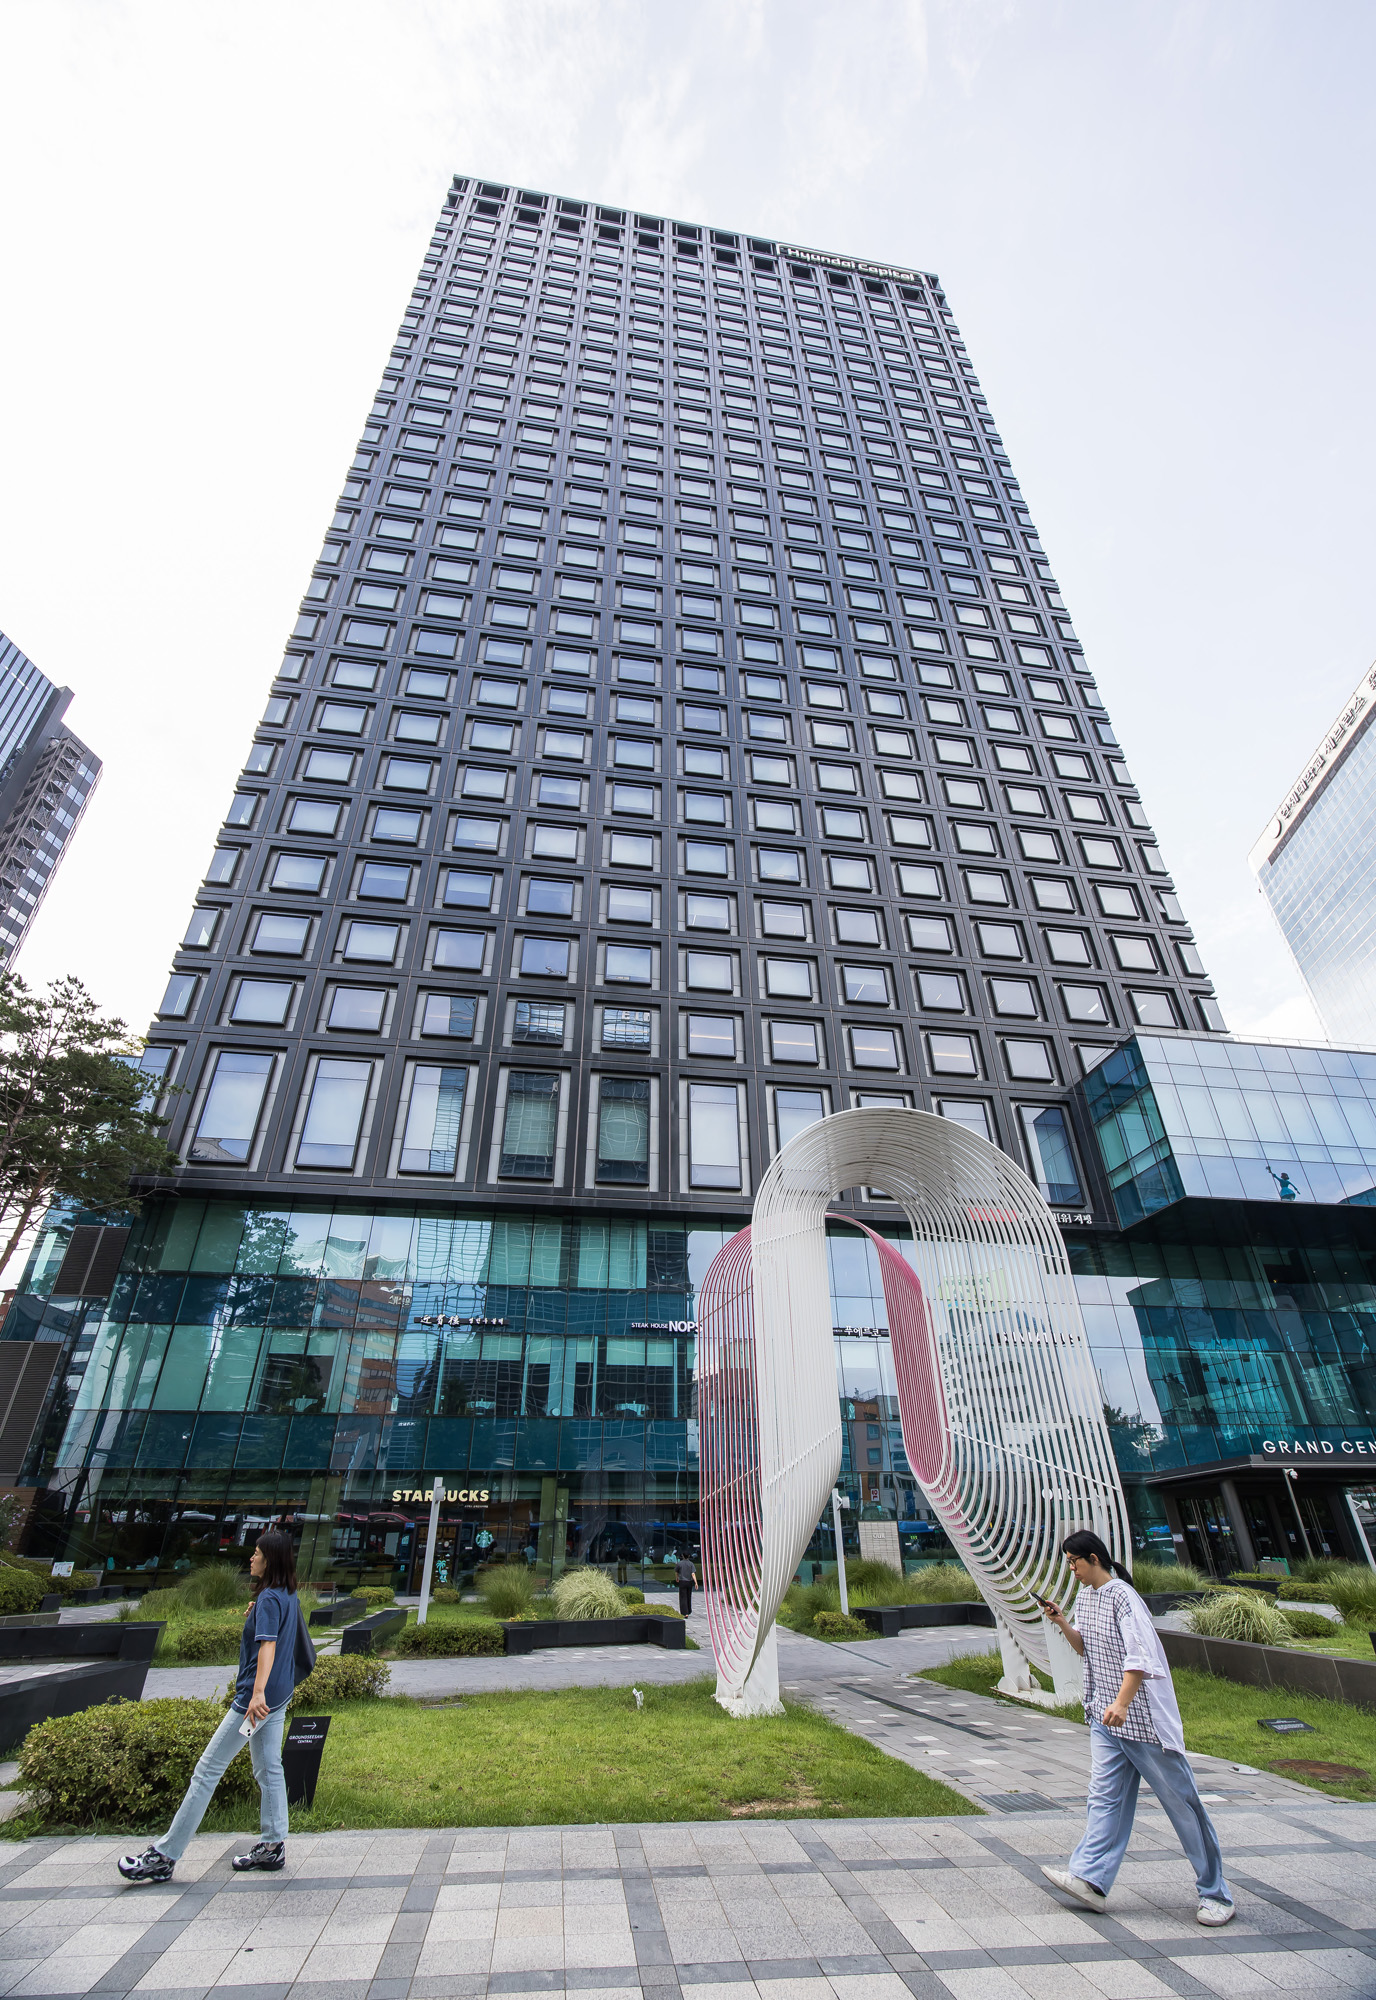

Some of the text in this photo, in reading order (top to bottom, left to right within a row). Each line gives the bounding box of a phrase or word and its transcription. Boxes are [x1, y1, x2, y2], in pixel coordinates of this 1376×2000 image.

[788, 248, 915, 281] Hyundai Capital
[1325, 696, 1368, 755] 세브란스
[1073, 1213, 1092, 1225] 지평
[843, 1325, 882, 1337] 푸에르코
[1262, 1440, 1334, 1454] GRAND
[392, 1489, 490, 1502] STARUCKS
